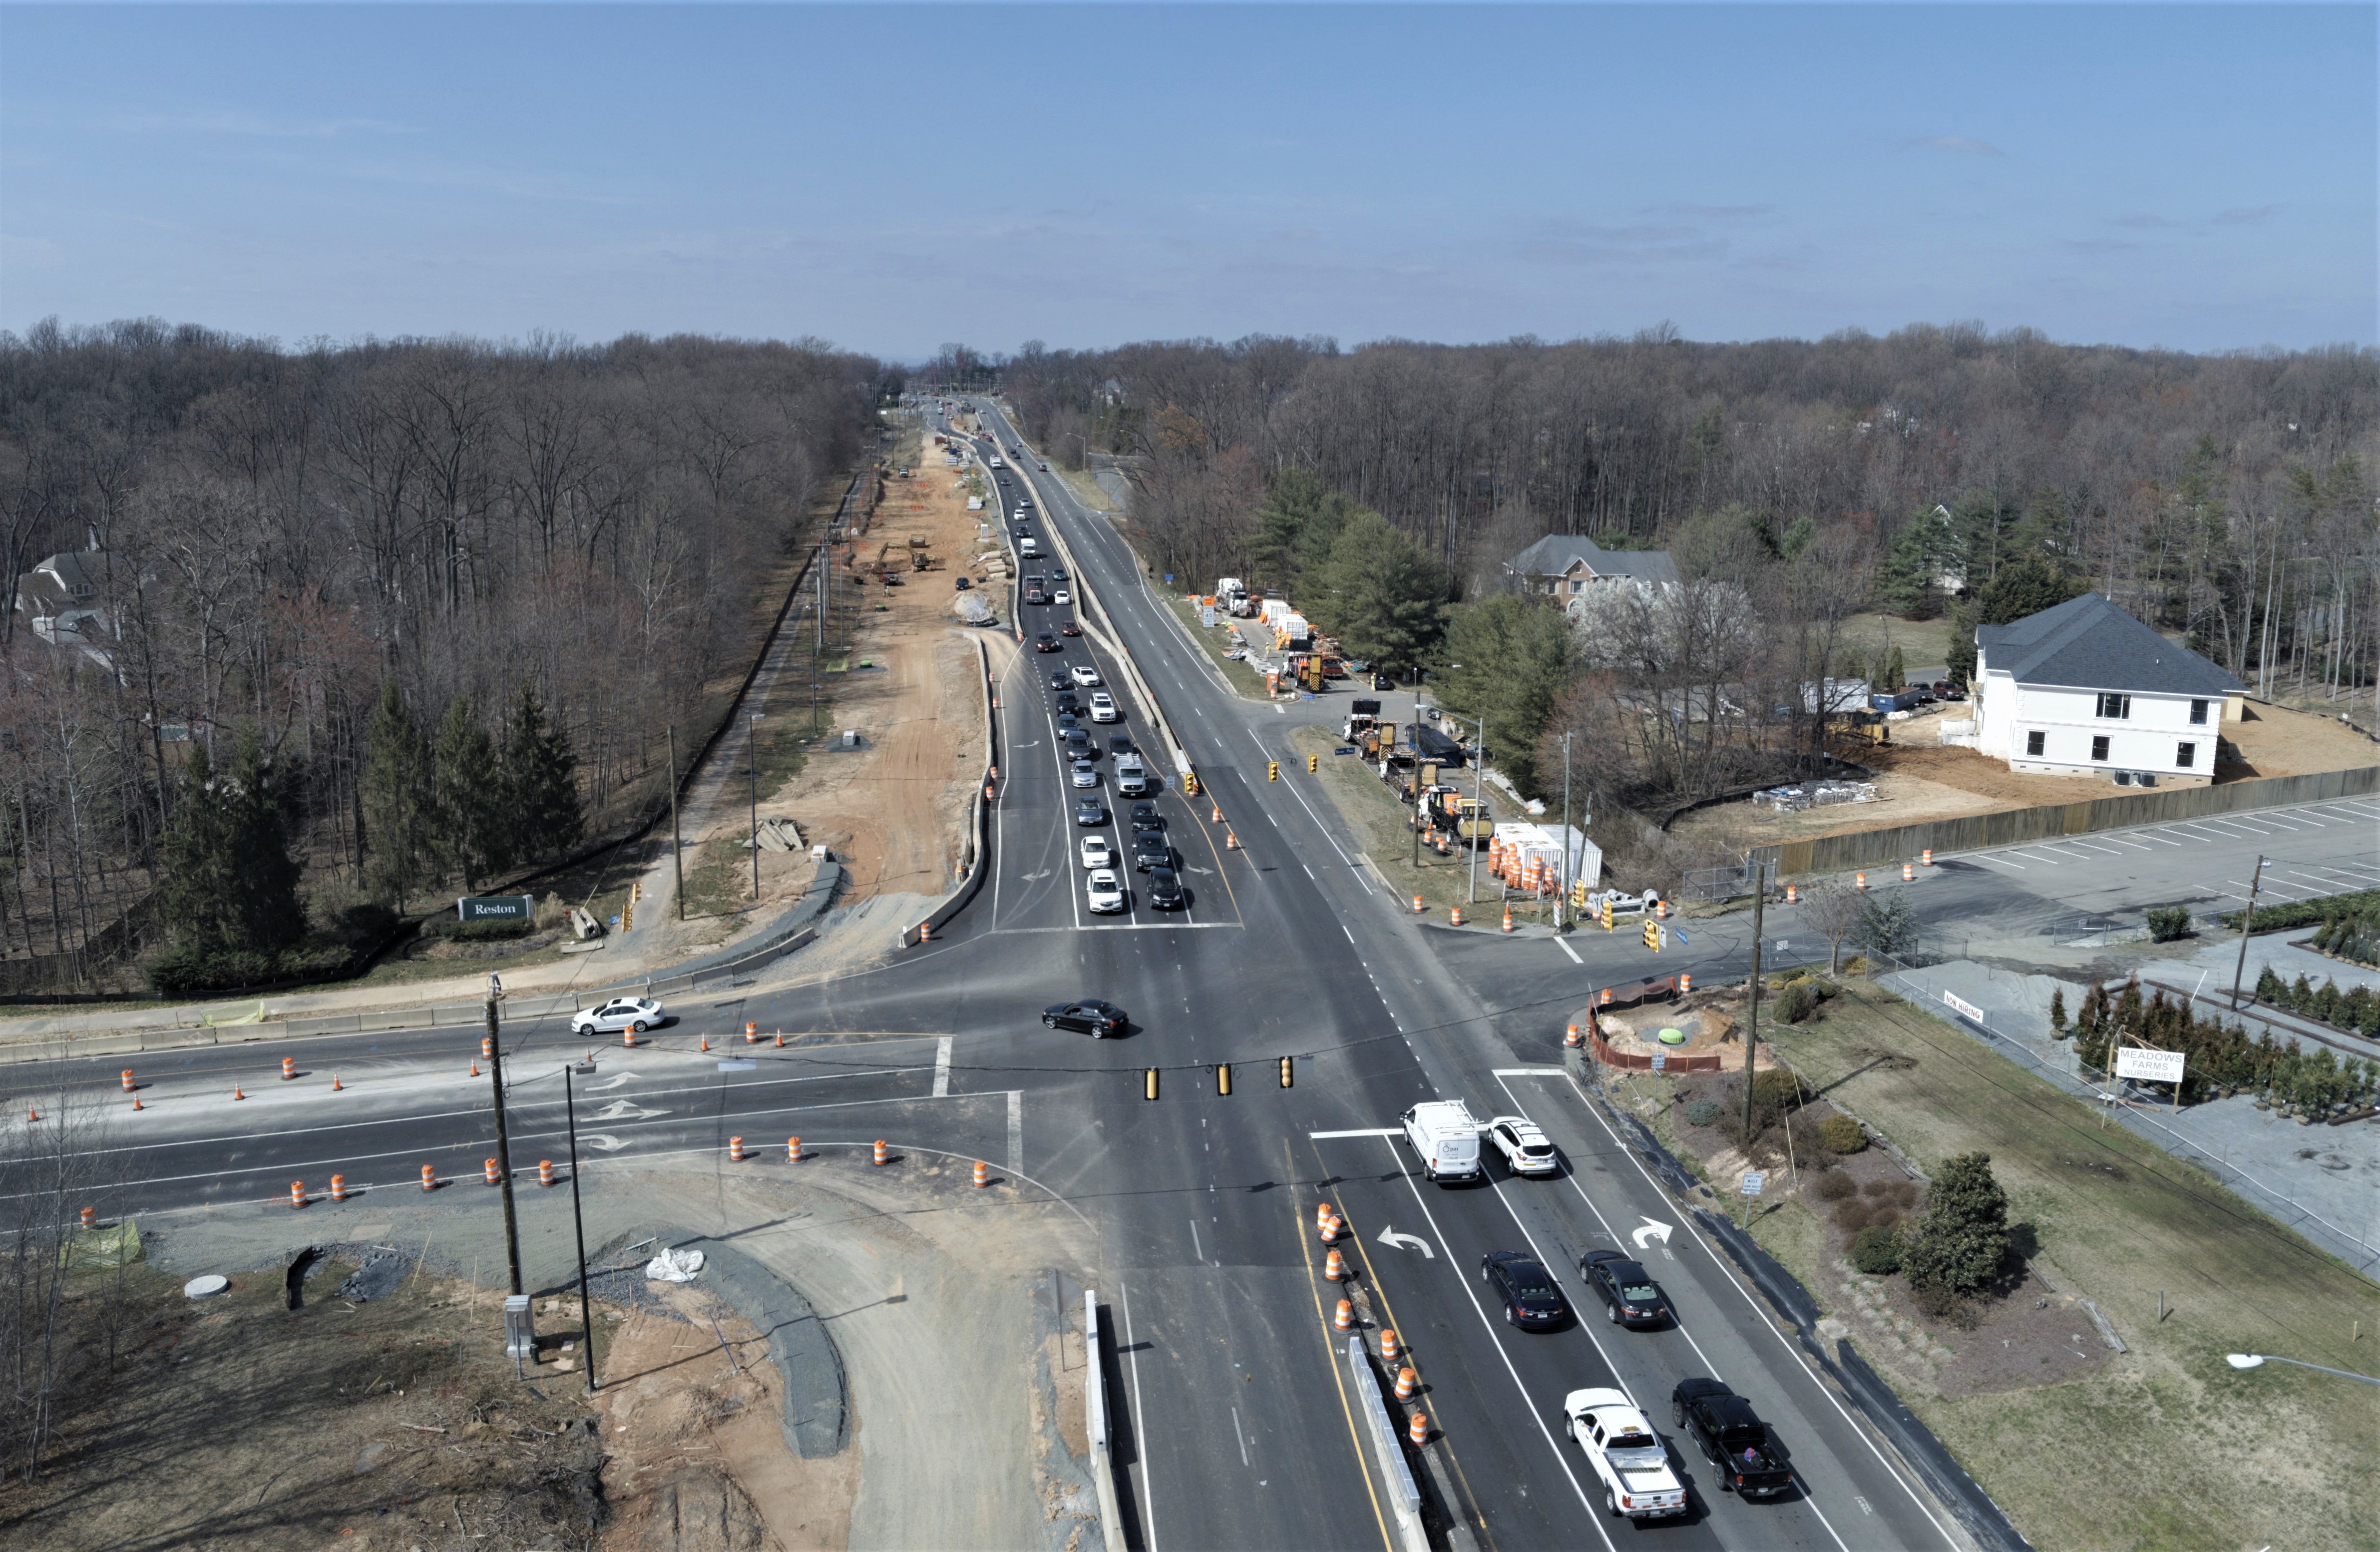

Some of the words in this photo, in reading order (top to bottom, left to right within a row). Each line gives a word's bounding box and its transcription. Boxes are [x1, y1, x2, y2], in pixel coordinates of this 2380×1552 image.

[475, 904, 516, 915] Reston
[1946, 995, 1957, 1007] NOW
[1959, 1002, 1980, 1019] HIRING
[2120, 1049, 2182, 1063] MEADOWS
[2132, 1060, 2168, 1070] FARMS
[2124, 1068, 2175, 1079] NURSERIES
